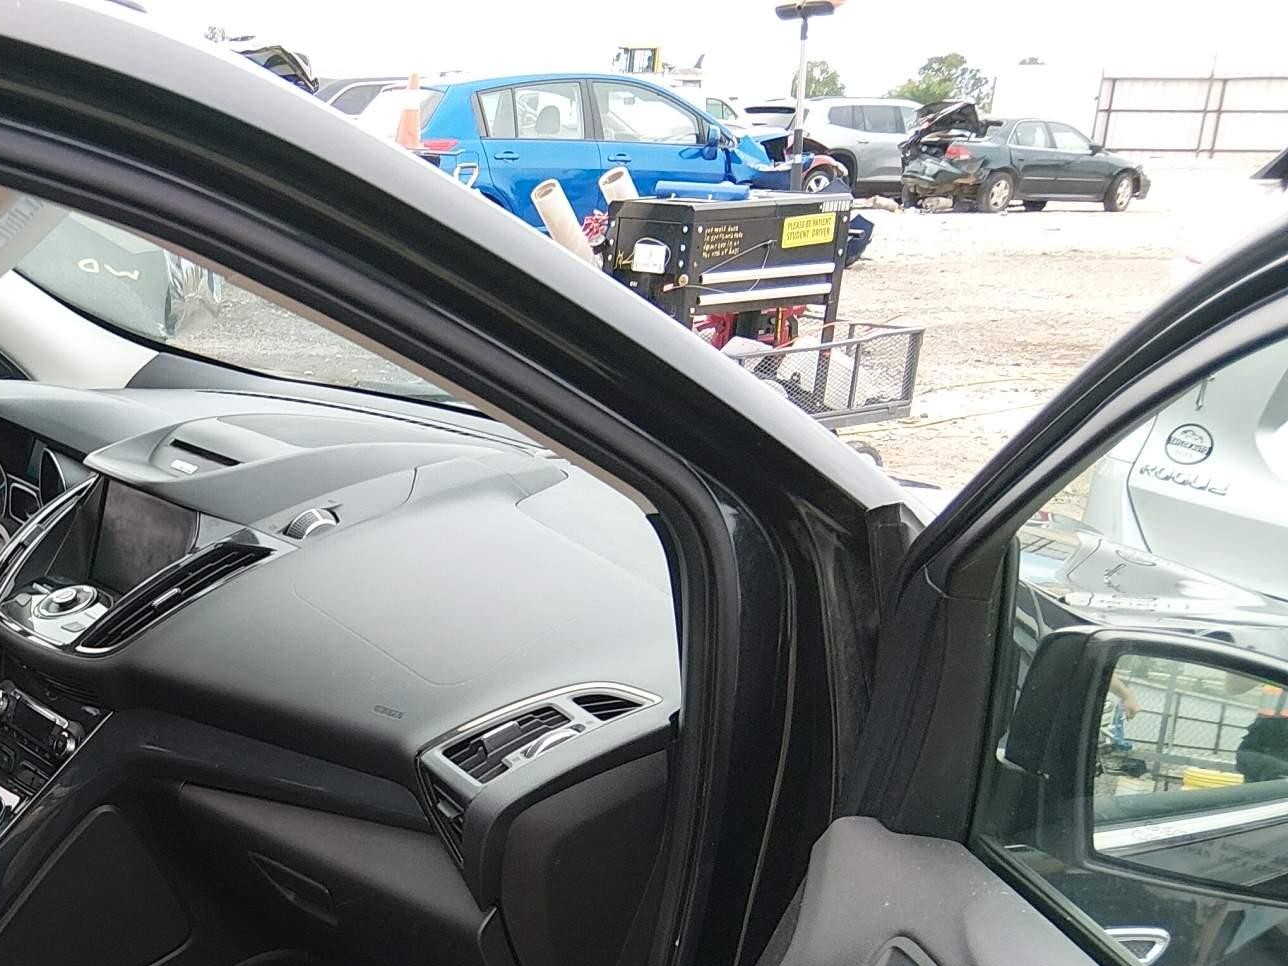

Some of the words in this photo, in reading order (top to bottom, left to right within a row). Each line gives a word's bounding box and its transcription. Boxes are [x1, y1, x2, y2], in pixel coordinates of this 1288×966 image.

[787, 219, 805, 231] PLEASE
[812, 217, 832, 227] PATIENT
[786, 228, 810, 241] STUDENT
[811, 226, 830, 238] DRIVER
